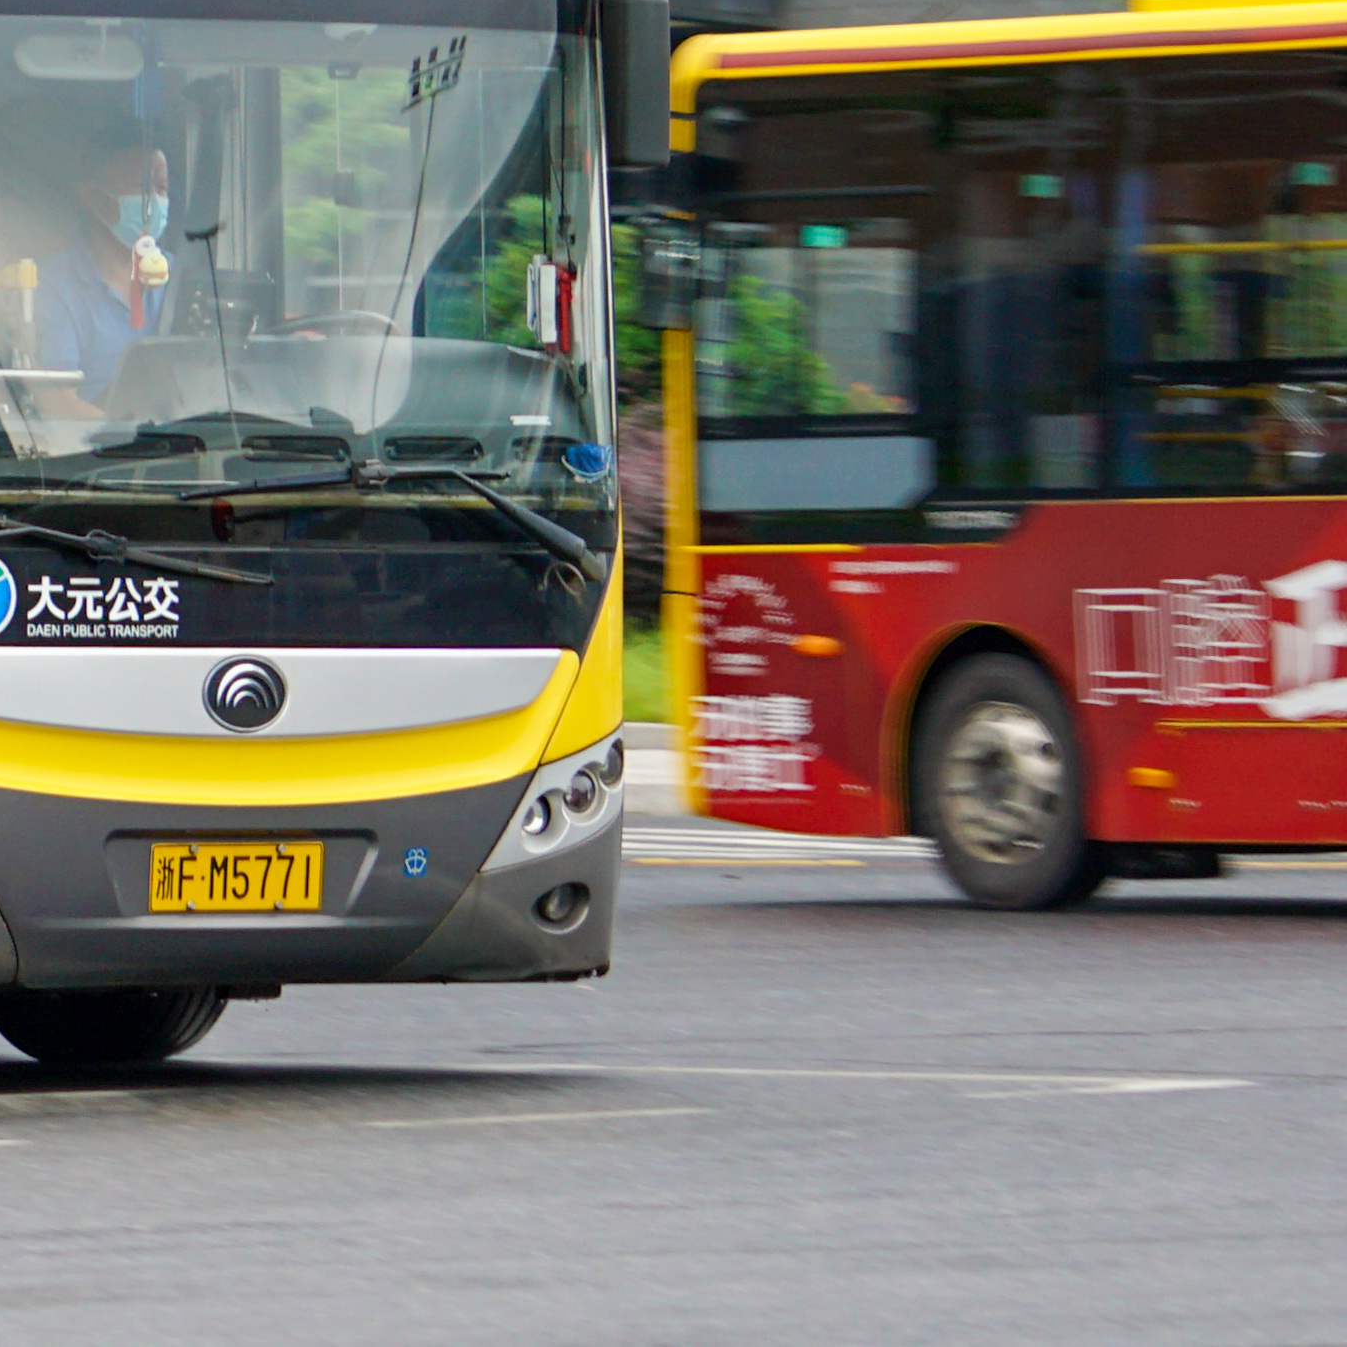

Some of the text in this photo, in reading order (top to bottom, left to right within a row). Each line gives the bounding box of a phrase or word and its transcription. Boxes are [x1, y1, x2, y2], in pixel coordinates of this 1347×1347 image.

[26, 575, 180, 622] 大元公交
[26, 624, 179, 639] DAEN PUBLIC TRANSPORT
